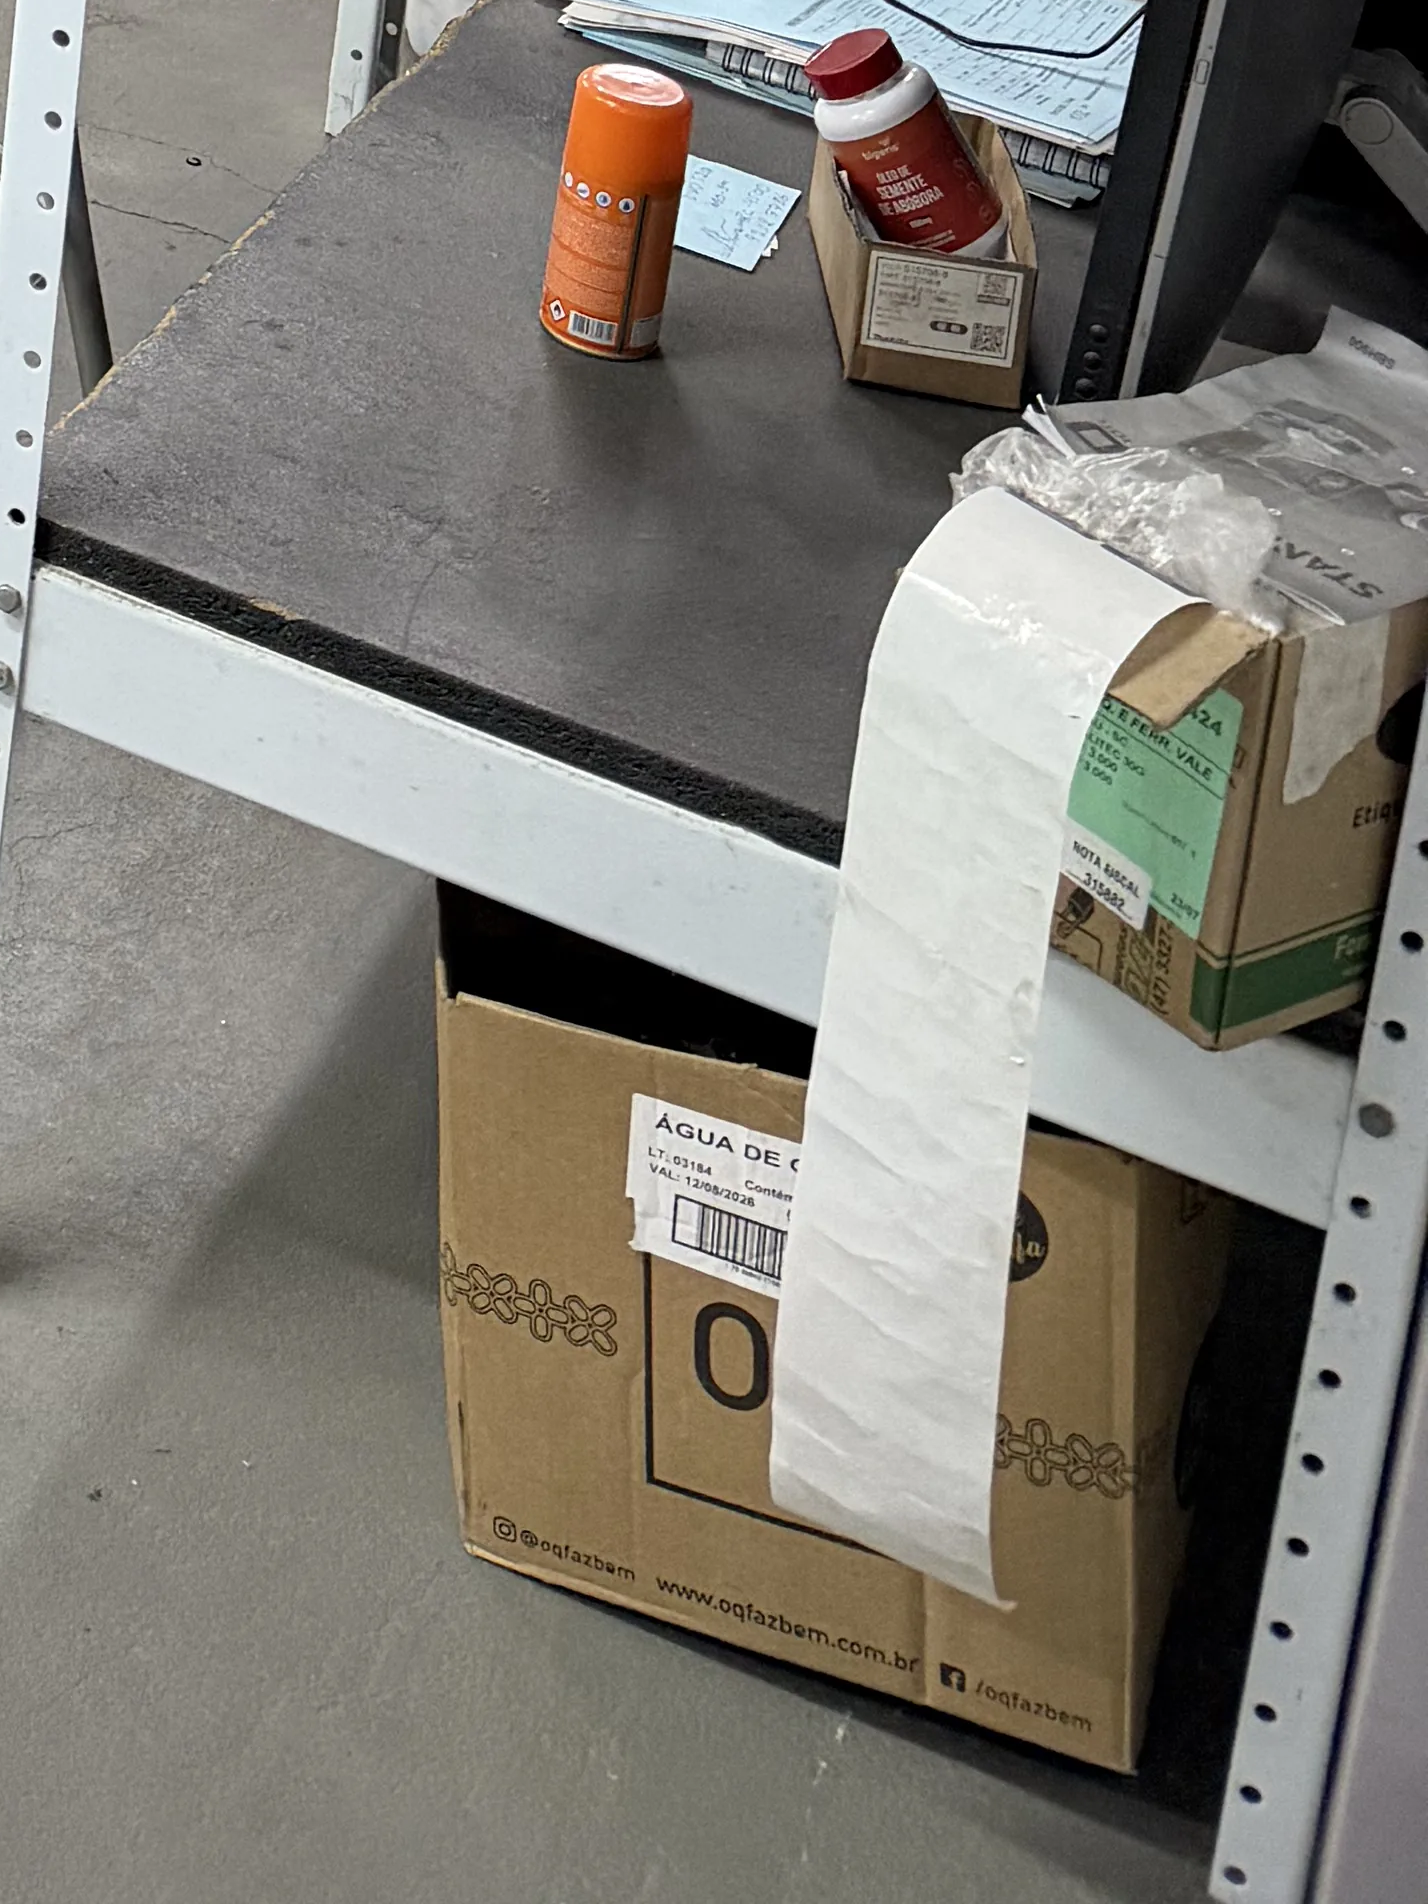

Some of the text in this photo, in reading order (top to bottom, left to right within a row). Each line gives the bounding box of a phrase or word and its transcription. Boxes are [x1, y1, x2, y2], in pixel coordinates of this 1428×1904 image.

[875, 172, 929, 201] SEMENTE
[892, 185, 945, 217] ABÓBORA
[1119, 707, 1129, 725] E
[1176, 745, 1215, 783] VALE
[1352, 800, 1402, 829] Etiq
[1072, 838, 1102, 870] NOTA
[654, 1112, 735, 1154] ÁGUA
[743, 1143, 781, 1168] DE
[649, 1162, 681, 1182] VAL:
[672, 1155, 714, 1177] 03184
[519, 1529, 636, 1582] @oqfazbem
[655, 1575, 921, 1676] www.oqfazbem.com.br
[974, 1677, 1094, 1734] /oqfazbem
